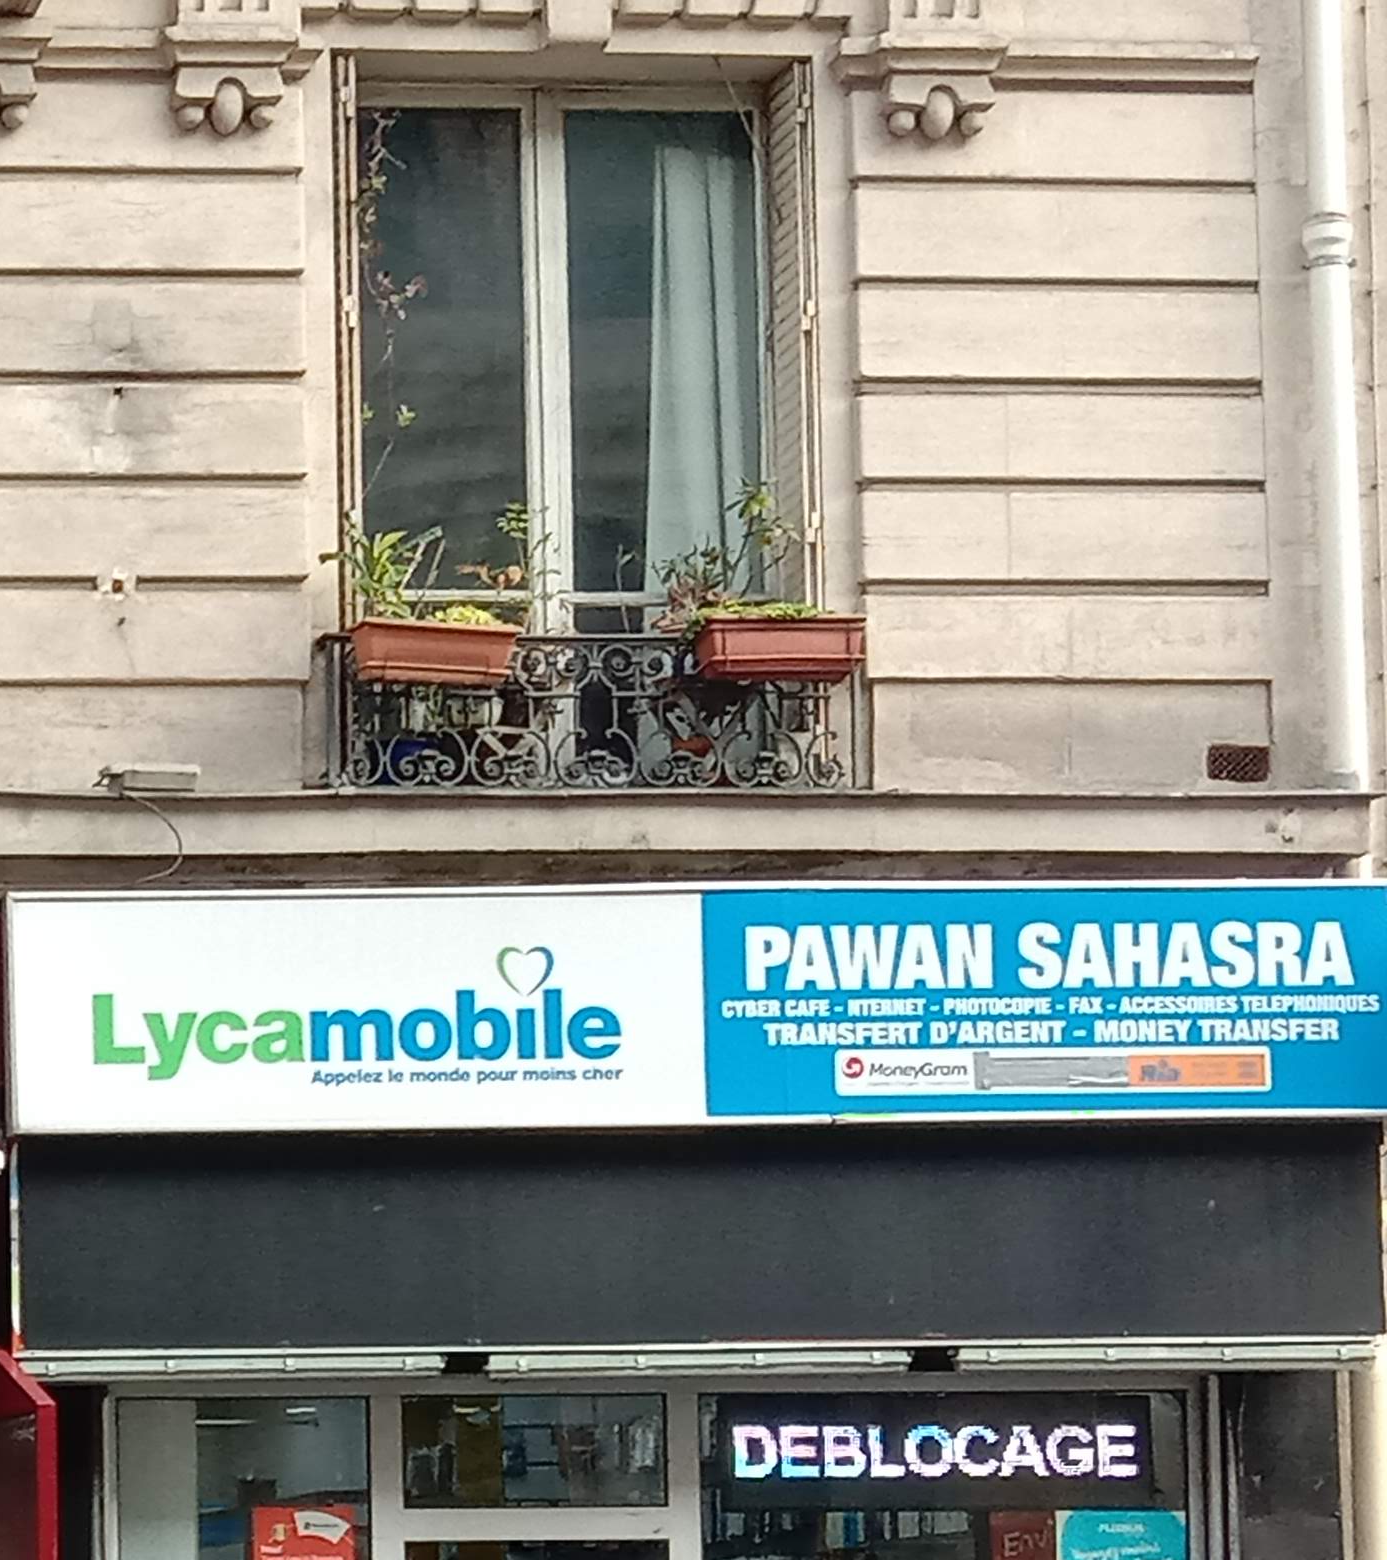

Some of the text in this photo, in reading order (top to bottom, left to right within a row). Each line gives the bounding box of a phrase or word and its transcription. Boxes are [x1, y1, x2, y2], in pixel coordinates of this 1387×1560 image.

[746, 921, 1355, 991] PAWAN SAHASRA
[722, 1000, 781, 1017] CYBER
[784, 999, 830, 1017] CAFE
[943, 997, 1052, 1015] PHOTOCOPIE
[1069, 997, 1103, 1014] FAX
[1119, 996, 1239, 1014] ACCESSOIRES
[1241, 994, 1380, 1013] TELEPHONIQUES
[92, 989, 623, 1081] Lycamobile
[763, 1017, 1340, 1046] TRANSFERT D'ARGENT MONEY TRANSFER
[311, 1067, 624, 1087] Appelez le monde pour moins cher
[869, 1061, 968, 1079] MoneyGram
[731, 1423, 1138, 1479] DEBLOCAGE
